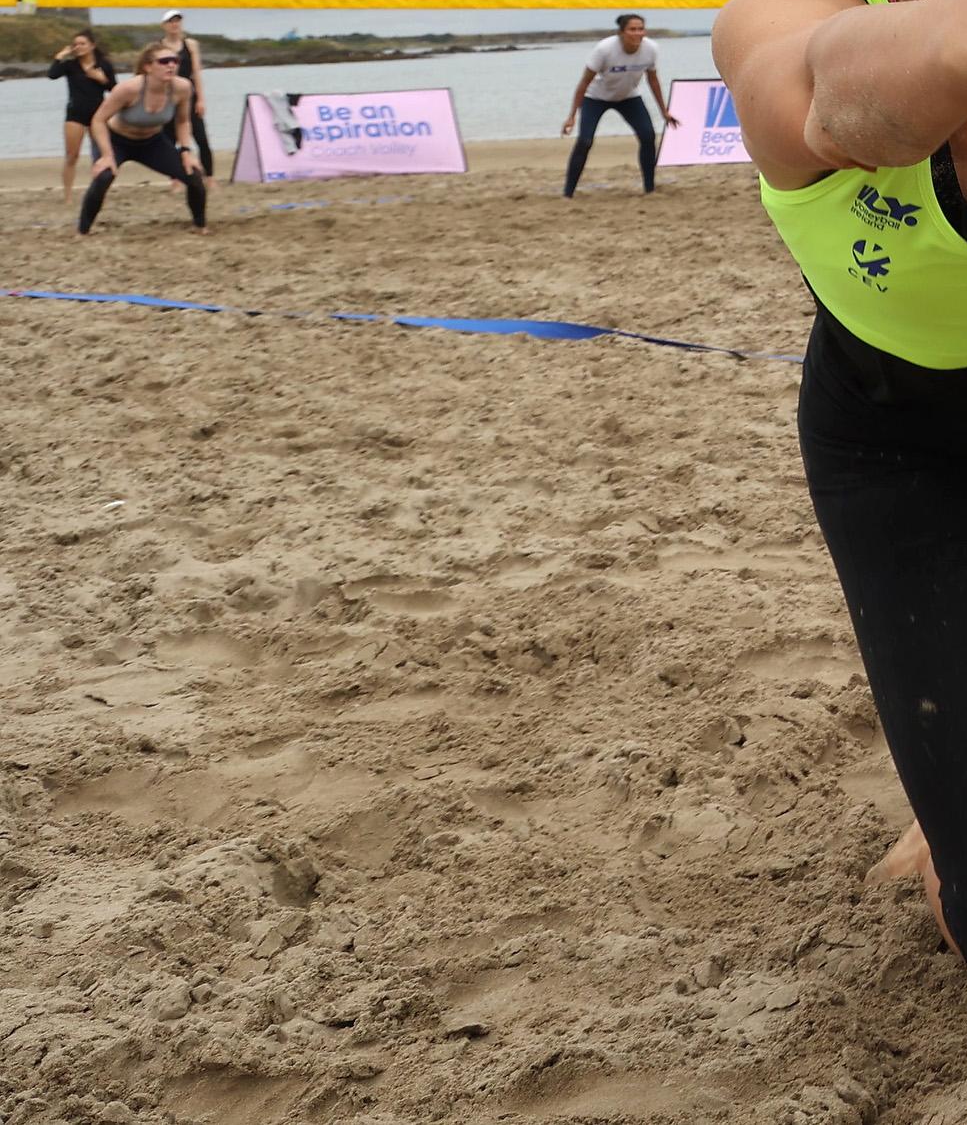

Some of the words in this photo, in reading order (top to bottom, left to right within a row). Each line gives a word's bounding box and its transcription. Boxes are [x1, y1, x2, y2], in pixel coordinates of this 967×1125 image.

[317, 104, 352, 122] Be
[360, 104, 394, 120] an
[703, 86, 742, 128] VL
[301, 120, 432, 141] nspiration
[701, 131, 742, 144] Beac
[699, 144, 735, 156] Tour
[850, 206, 885, 231] Ireland
[848, 267, 888, 293] CEV
